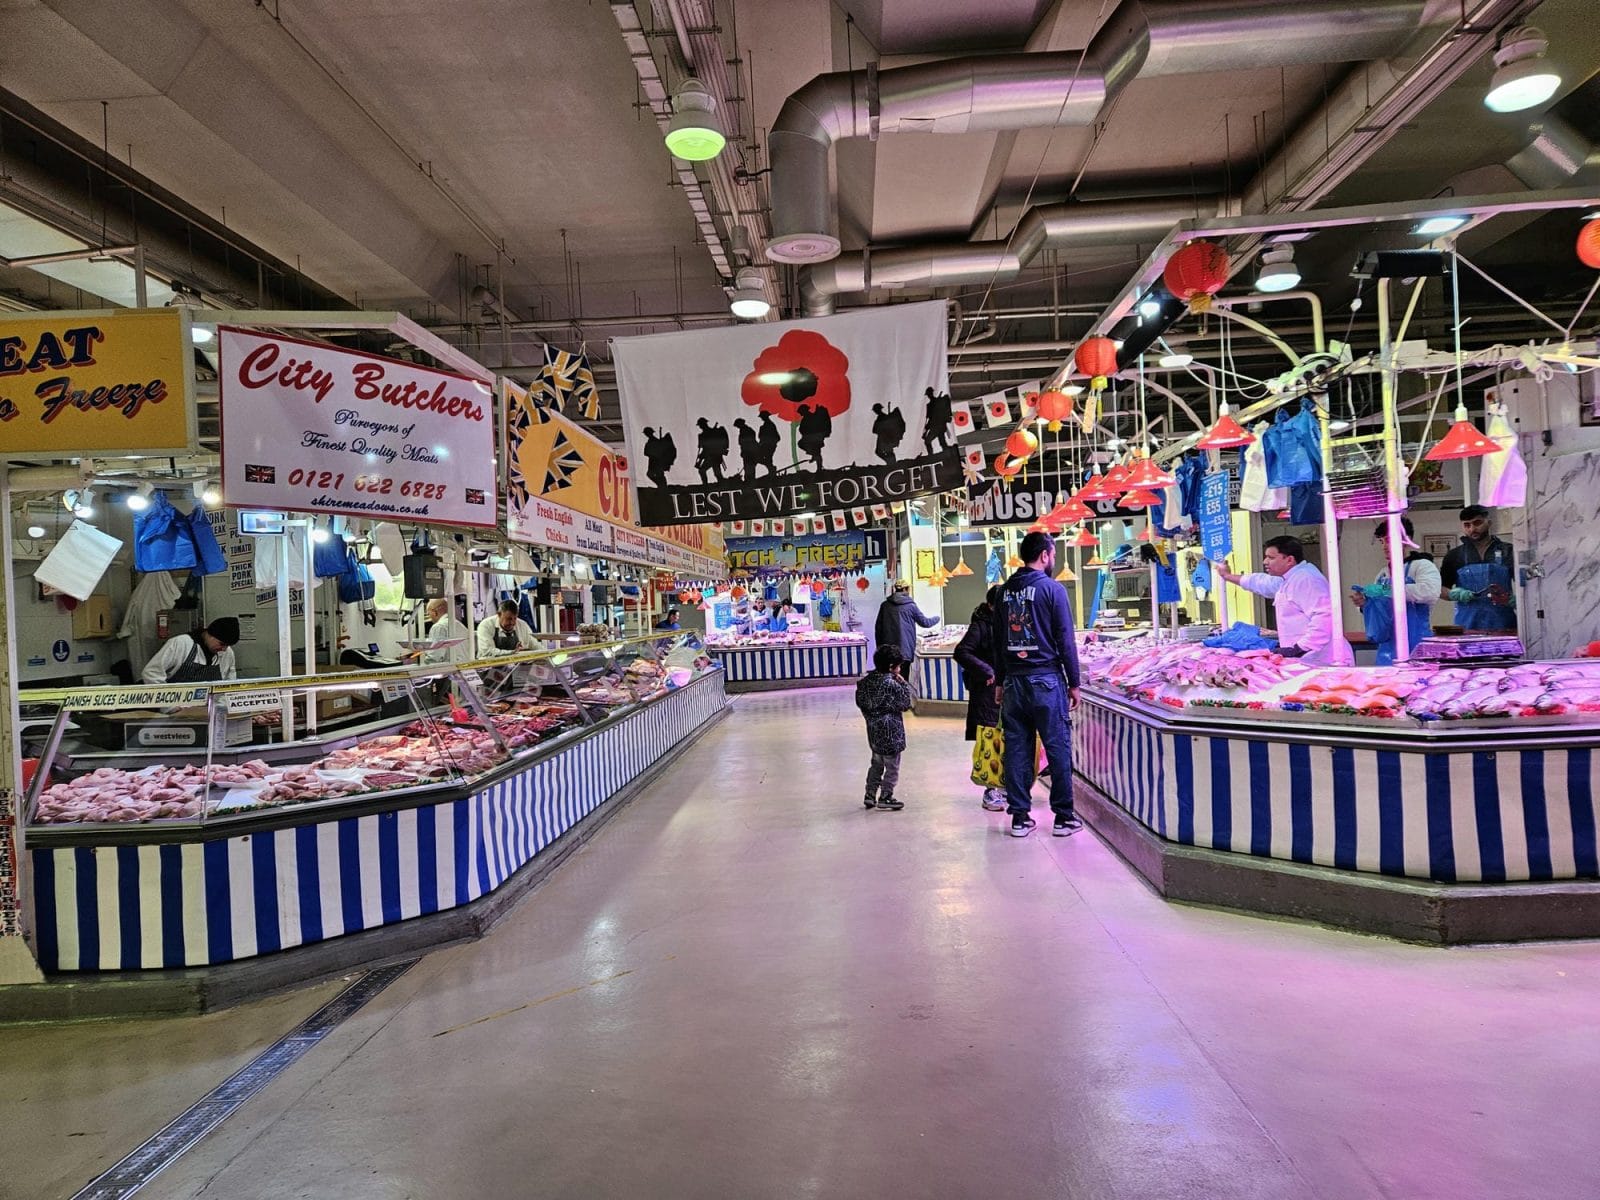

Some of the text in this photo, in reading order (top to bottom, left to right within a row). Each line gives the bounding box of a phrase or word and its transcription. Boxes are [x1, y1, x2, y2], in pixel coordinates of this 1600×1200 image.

[238, 343, 485, 422] City Butchers
[34, 376, 168, 424] Freeze
[335, 409, 416, 439] Purveyors of
[300, 430, 439, 464] Finest Quality Meats
[288, 468, 447, 500] 0121 622 6828
[669, 461, 944, 519] LEST WE FORGET
[311, 494, 429, 515] shiremeadows.co.uk
[536, 502, 554, 520] Fresh
[554, 508, 574, 526] English
[796, 543, 863, 564] FRESH
[231, 563, 252, 571] THICK
[232, 571, 252, 580] PORK
[231, 579, 254, 588] SPECIAL
[64, 695, 91, 707] DANISH
[92, 694, 116, 706] SLICES
[118, 693, 153, 705] GAMMON
[155, 691, 181, 703] BACON
[231, 698, 279, 708] ACCEPTED
